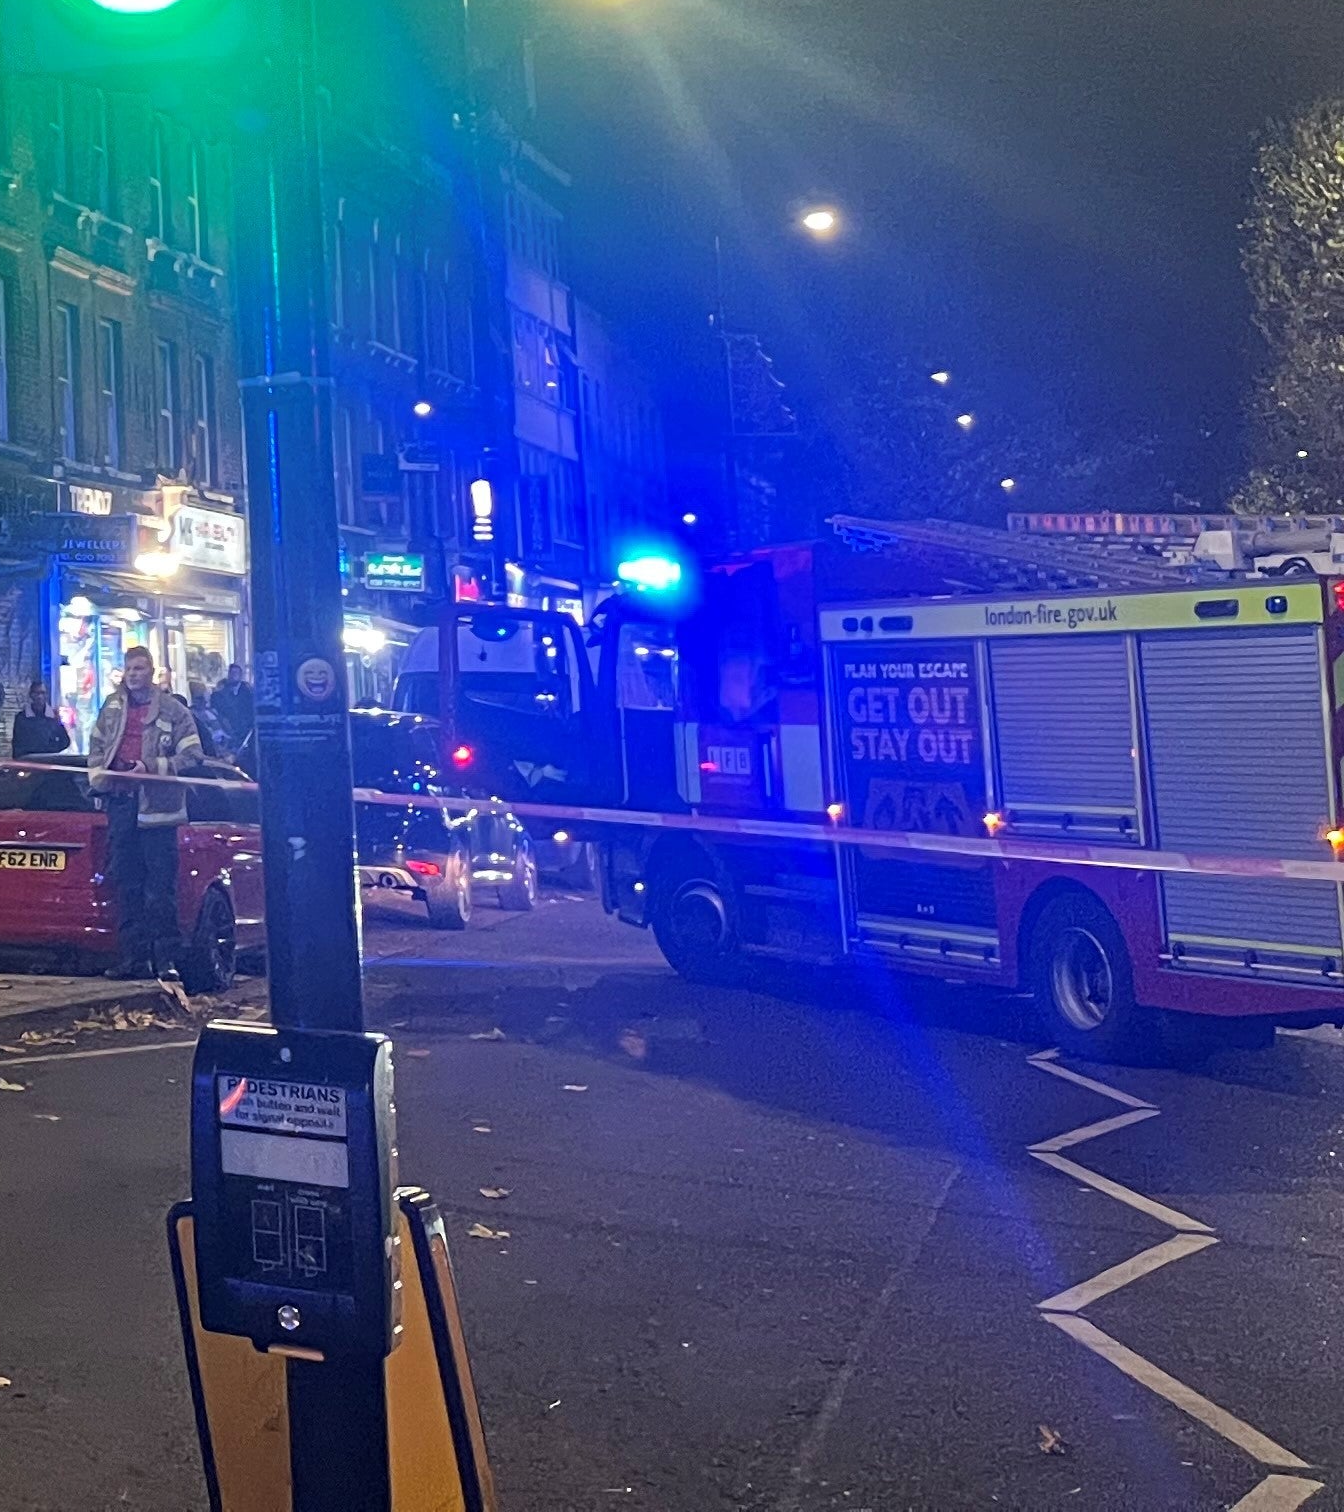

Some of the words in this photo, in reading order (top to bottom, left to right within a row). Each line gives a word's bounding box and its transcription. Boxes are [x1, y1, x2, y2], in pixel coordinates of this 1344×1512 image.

[984, 600, 1118, 629] london-fire.gov.uk
[844, 663, 877, 679] PLAN
[880, 663, 915, 679] YOUR
[918, 663, 969, 679] ESCAPE
[847, 686, 900, 724] GET
[907, 686, 969, 725] OUT
[851, 728, 910, 762] STAY
[917, 729, 973, 764] OUT
[29, 852, 59, 867] ENR
[227, 1078, 340, 1104] PDESTRIANS
[235, 1110, 250, 1119] for
[252, 1113, 285, 1124] signal
[256, 1098, 292, 1111] button
[293, 1104, 315, 1114] and
[316, 1107, 341, 1118] wait
